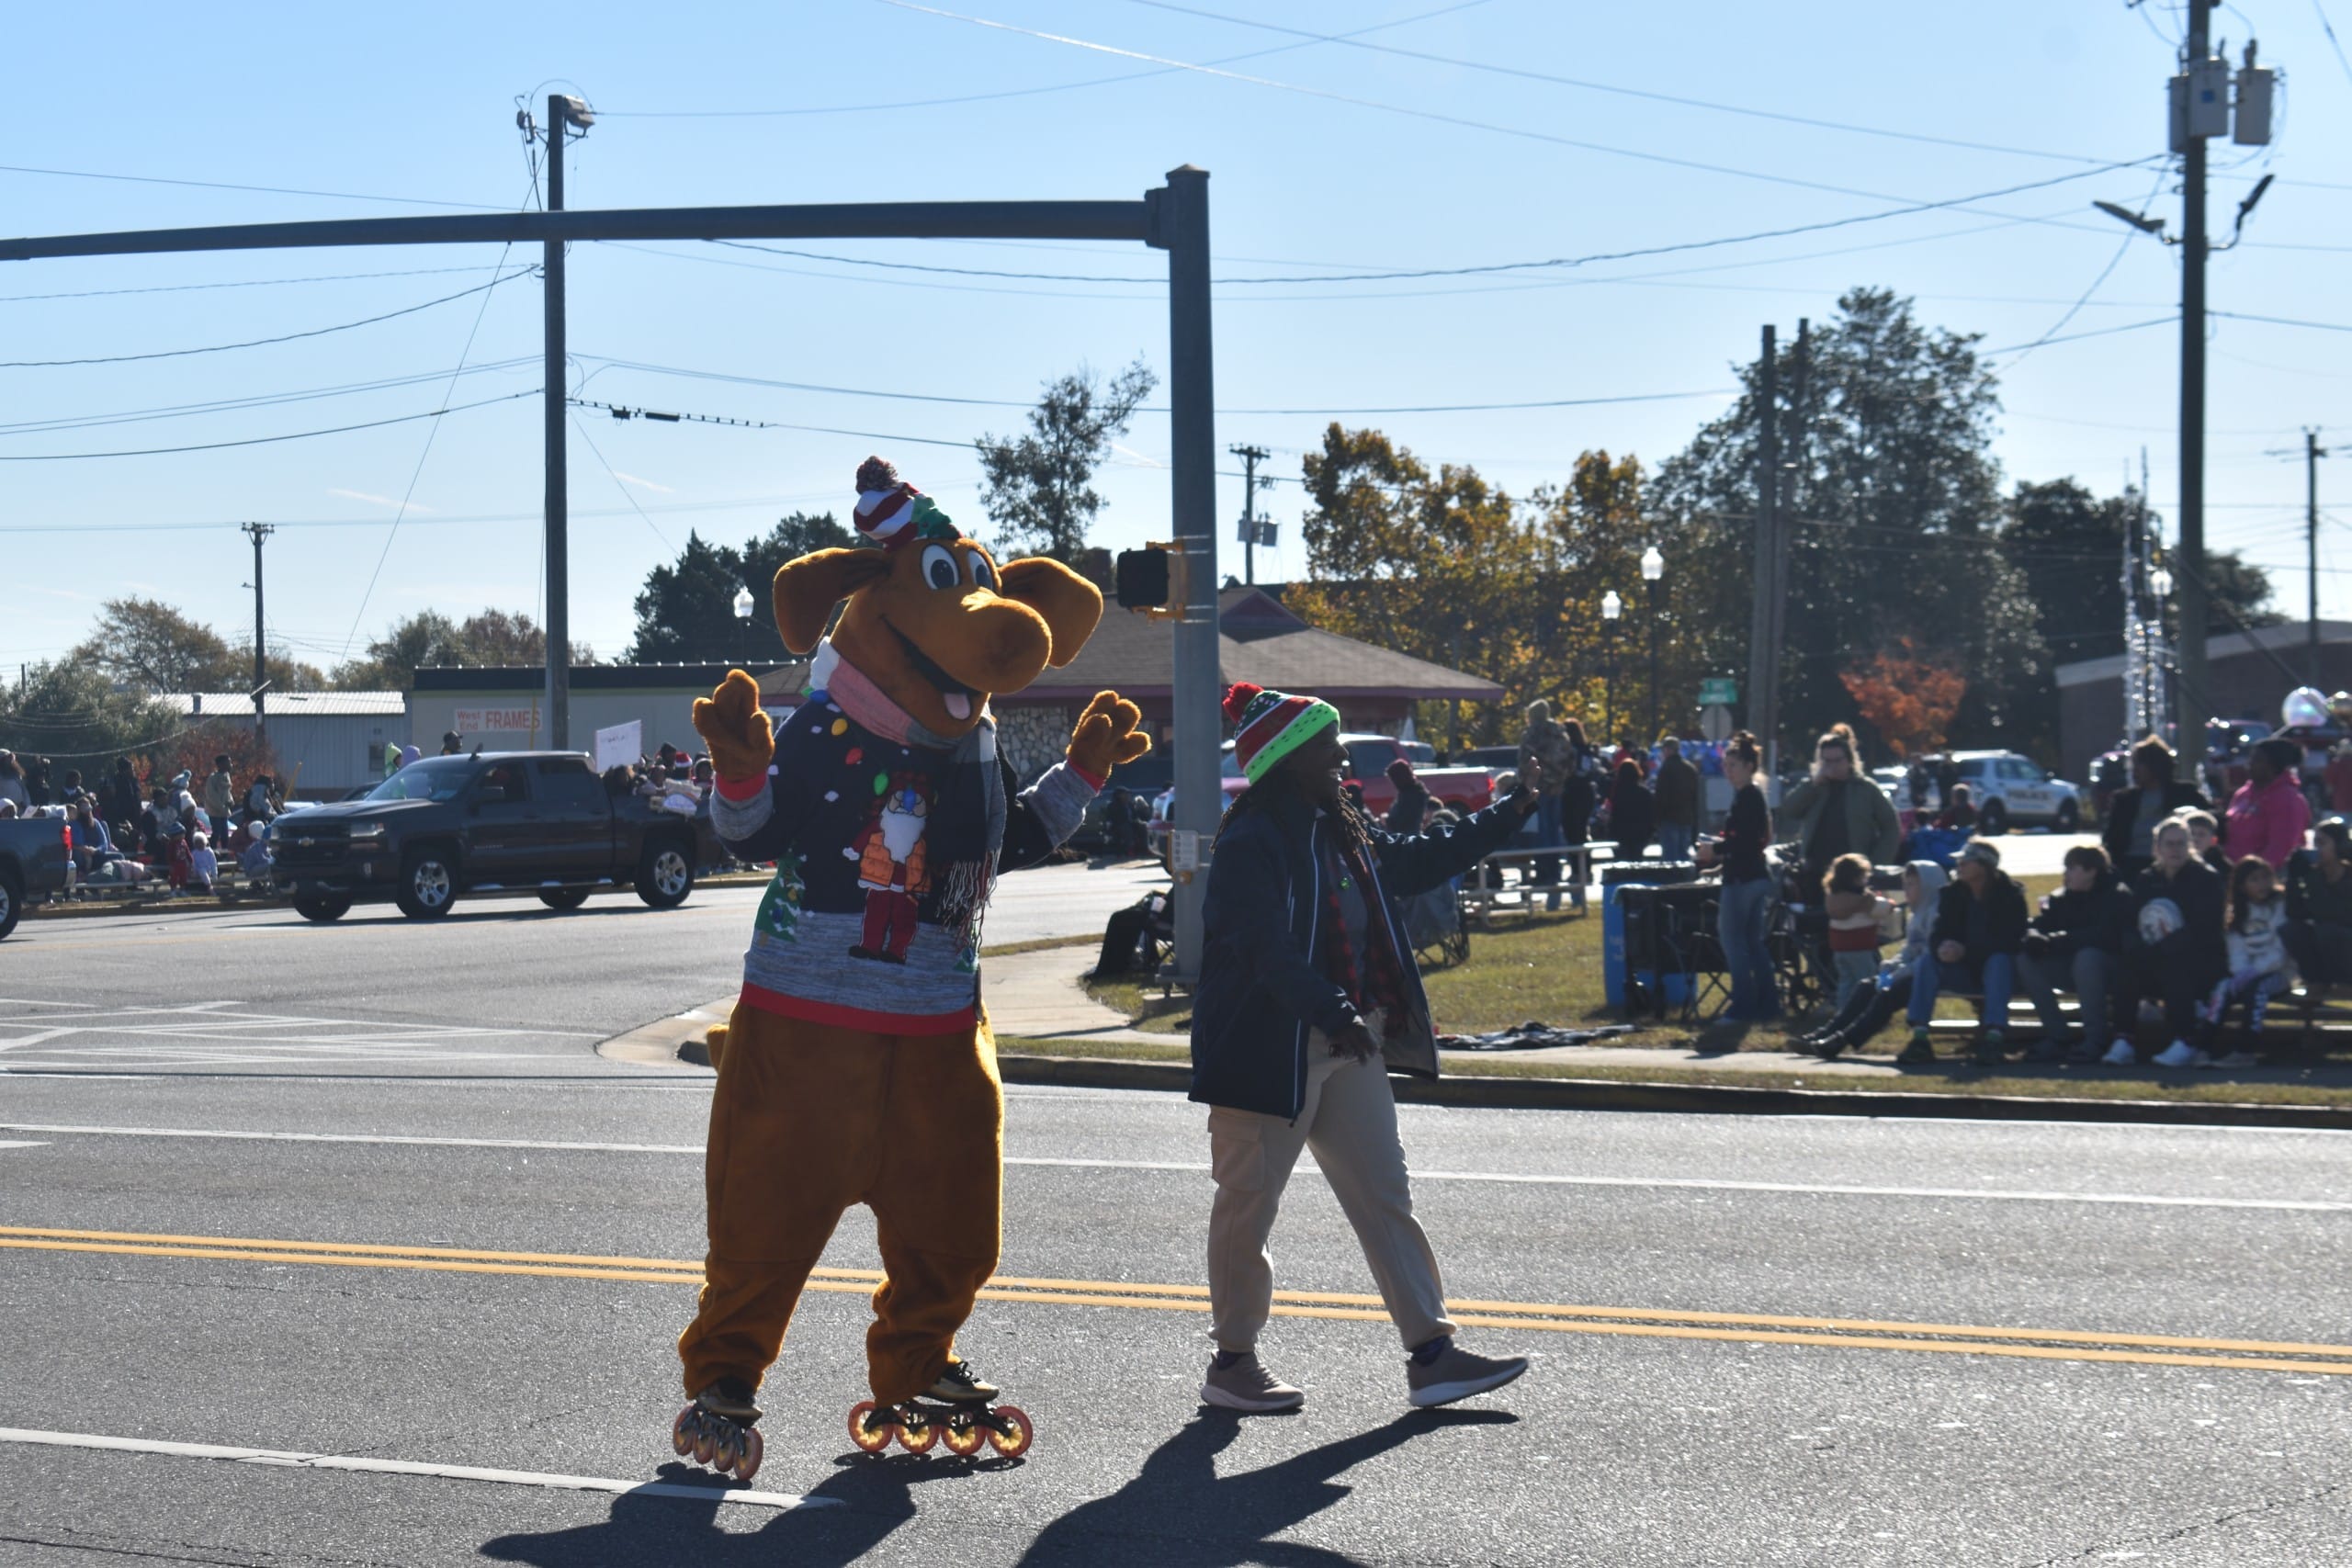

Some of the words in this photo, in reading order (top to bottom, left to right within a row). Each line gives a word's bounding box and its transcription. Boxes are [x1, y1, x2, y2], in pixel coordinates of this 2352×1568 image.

[458, 711, 481, 720] West
[485, 710, 540, 728] FRAMES
[459, 722, 479, 731] End
